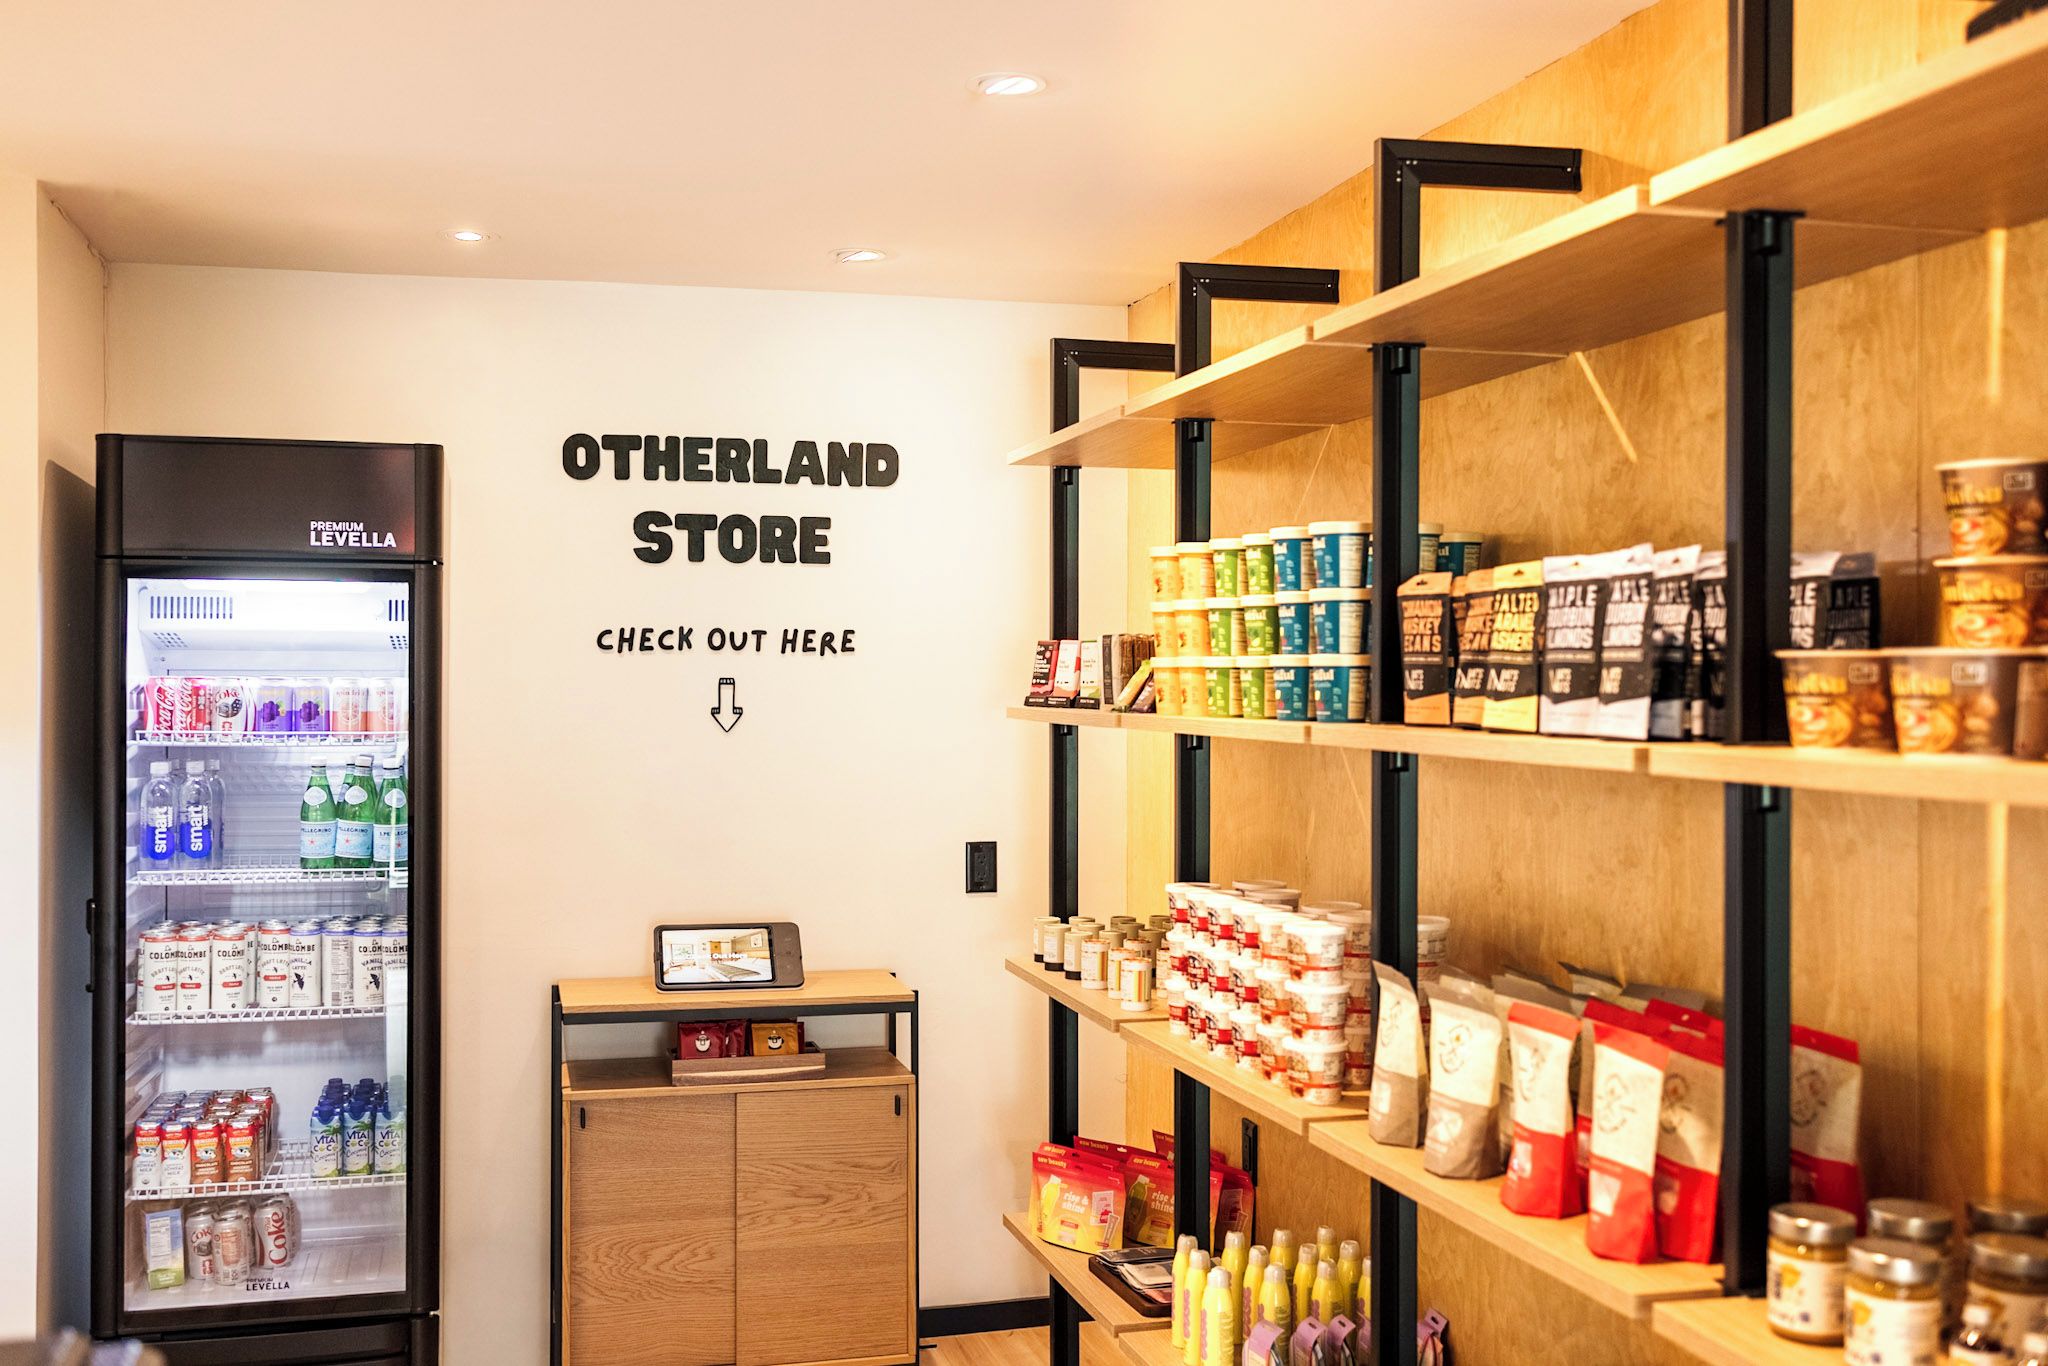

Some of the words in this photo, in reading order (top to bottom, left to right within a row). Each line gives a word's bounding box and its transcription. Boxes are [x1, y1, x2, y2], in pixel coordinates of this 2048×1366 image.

[562, 433, 900, 487] OTHERLAND
[310, 521, 364, 531] PREMIUM
[309, 532, 397, 548] LEVELLA
[633, 511, 831, 564] STORE
[597, 626, 694, 654] CHECK
[707, 628, 767, 653] OUT
[781, 629, 856, 657] HERE
[155, 805, 168, 854] smart
[188, 804, 203, 852] smart
[315, 1135, 336, 1145] VITA
[347, 1130, 367, 1140] VITA
[380, 1129, 401, 1140] VITA
[313, 1144, 338, 1153] COCO
[345, 1140, 370, 1148] COCO
[1063, 1191, 1081, 1202] rise
[1151, 1190, 1169, 1201] rise
[1061, 1201, 1086, 1214] shine
[191, 1226, 214, 1244] Cok
[268, 1211, 289, 1265] Coke
[246, 1281, 290, 1291] LEVELLA
